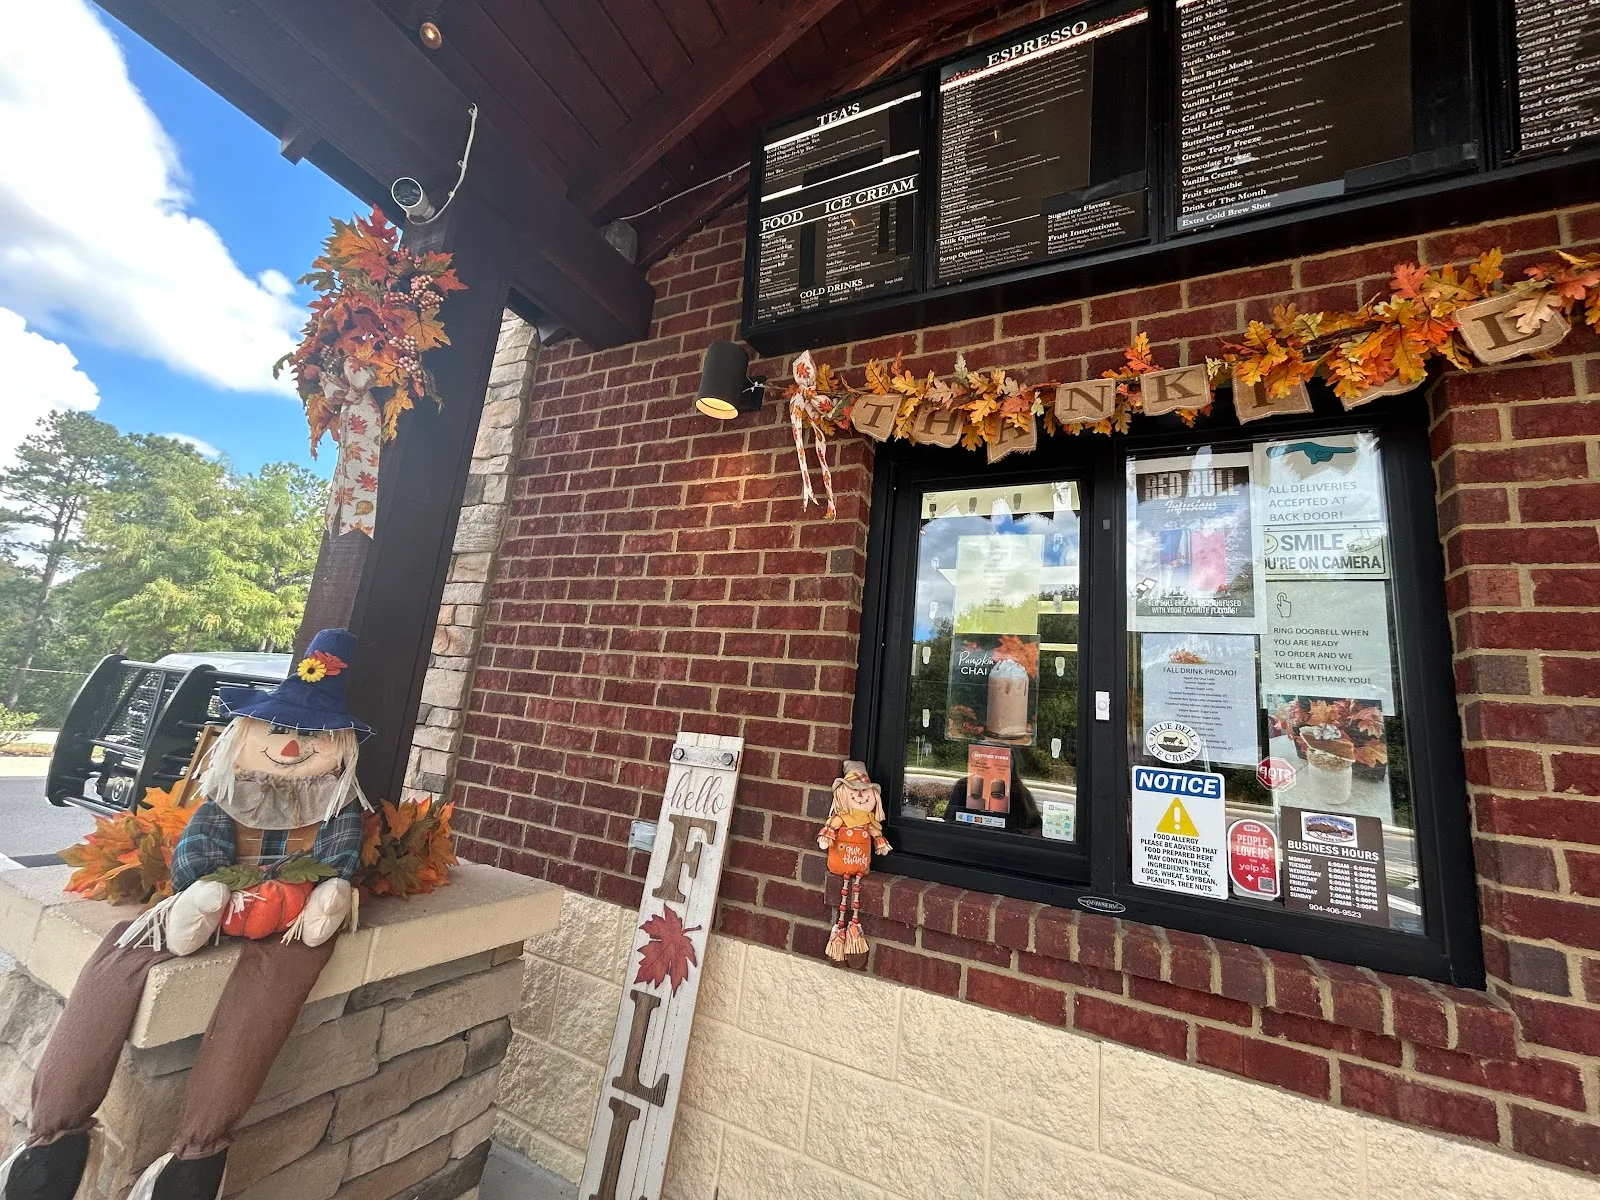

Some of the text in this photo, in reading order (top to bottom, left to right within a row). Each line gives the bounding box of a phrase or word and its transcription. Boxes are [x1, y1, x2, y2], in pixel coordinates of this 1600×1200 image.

[1205, 8, 1228, 19] Mocha
[1181, 21, 1227, 39] White Mocha
[987, 21, 1088, 67] ESPRESSO
[1181, 31, 1235, 52] Cherry Mocha
[1181, 58, 1204, 68] Turtle
[1205, 49, 1232, 61] Mocha
[1181, 60, 1253, 85] Peanut Butter Mocha
[1181, 76, 1240, 97] Caramel Latte
[1181, 91, 1234, 109] Vanilla Latte
[817, 103, 860, 127] TEA'S
[1209, 105, 1231, 115] Latte
[1181, 119, 1224, 135] Chai Latte
[1181, 124, 1255, 149] Butterbeer Frozen
[1181, 136, 1262, 161] Green Teazy Freeze
[1181, 152, 1252, 174] Chocolate Freeze
[1181, 176, 1210, 187] Vanilla
[1181, 181, 1243, 200] Fruit Smoothie
[761, 177, 916, 232] FOOD ICE CREAM
[1181, 188, 1267, 214] Drink of The Month
[1047, 207, 1082, 220] Sugarfree
[1083, 200, 1111, 212] Flavors
[1181, 202, 1271, 227] Extra Cold Brew Shot
[940, 238, 957, 247] Milk
[958, 231, 987, 242] Options
[1048, 233, 1068, 242] Fruit
[1070, 221, 1120, 237] Innovations
[940, 248, 984, 263] Syrup Options
[800, 287, 825, 299] COLD
[827, 278, 863, 294] DRINKS
[1144, 468, 1240, 502] RED BULL
[1268, 481, 1357, 494] ALL DELIVERIES
[1268, 496, 1348, 508] ACCEPTED AT
[1269, 510, 1344, 522] BACK DOOR!
[1280, 533, 1344, 552] SMILE
[1264, 555, 1382, 570] U'RE ON CAMERA
[1273, 627, 1369, 637] RING DOORBELL WHEN
[1273, 638, 1291, 646] YOU
[1292, 639, 1309, 647] ARE
[959, 650, 995, 668] Pumpkin
[1287, 650, 1316, 658] ORDER
[960, 666, 988, 676] CHAI
[1162, 666, 1237, 677] FALL DRINK PROMO!
[1296, 662, 1307, 670] BE
[1308, 663, 1331, 671] WITH
[1333, 664, 1352, 672] YOU
[1274, 673, 1371, 685] SHORTLY! THANK YOU!
[1149, 722, 1197, 742] BLUE BELL
[1150, 743, 1197, 762] ICE CREAM
[1138, 771, 1219, 796] NOTICE
[666, 775, 728, 816] hello
[1140, 838, 1163, 847] PLEASE
[1173, 843, 1201, 853] ADVISED
[1201, 847, 1218, 855] THAT
[1153, 833, 1199, 845] FOOD ALLERGY
[1236, 833, 1268, 848] PEOPLE
[1144, 846, 1214, 862] FOOD PREPARED HERE
[1236, 845, 1270, 860] LOVE US
[1287, 840, 1379, 861] BUSINESS HOURS
[1147, 853, 1211, 869] MAY CONTAIN THESE
[1288, 855, 1312, 864] MONDAY
[1288, 861, 1312, 870] TUESDAY
[1147, 861, 1211, 877] INGREDIENTS: MILK,
[1238, 863, 1260, 873] yelp
[1288, 867, 1322, 877] WEDNESDAY
[1141, 867, 1160, 876] EGGS,
[1185, 874, 1218, 886] SOYBEAN,
[1146, 876, 1177, 887] PEANUTS,
[1177, 880, 1194, 889] TREE
[1195, 882, 1213, 892] NUTS
[1289, 873, 1318, 883] THURSDAY
[1289, 879, 1309, 887] FRIDAY
[1289, 885, 1318, 895] SATURDAY
[1329, 891, 1352, 900] 7:00AM
[1290, 891, 1312, 900] SUNDAY
[1308, 903, 1362, 919] 904-406-9523
